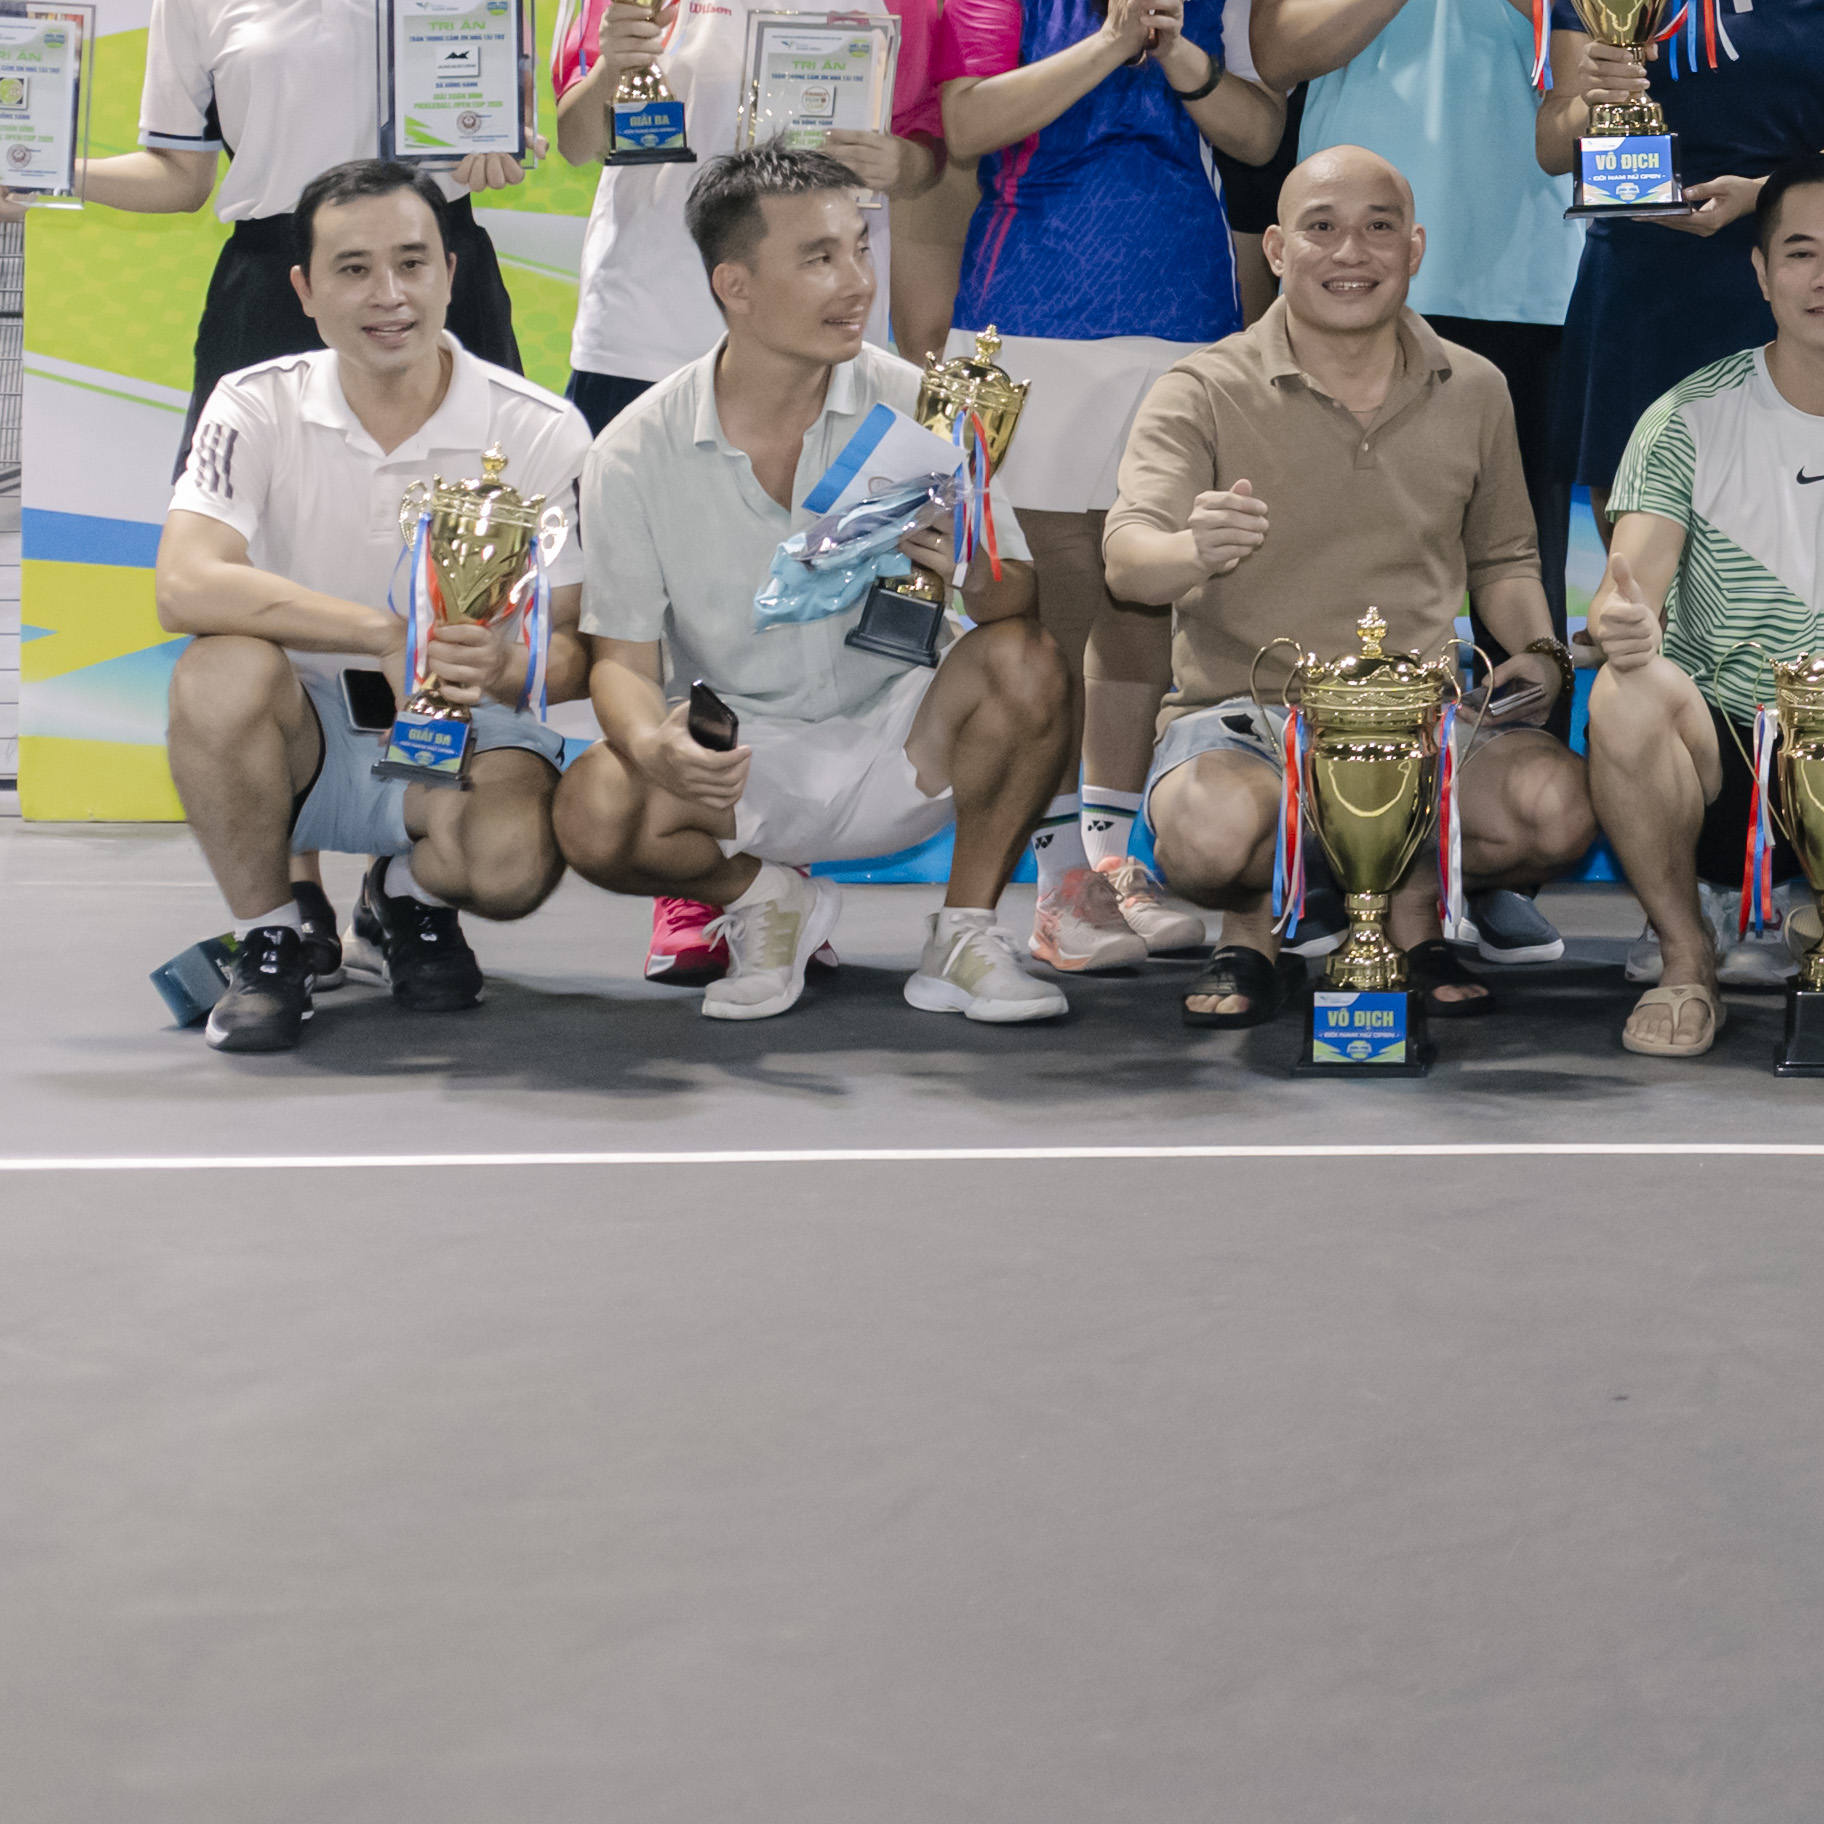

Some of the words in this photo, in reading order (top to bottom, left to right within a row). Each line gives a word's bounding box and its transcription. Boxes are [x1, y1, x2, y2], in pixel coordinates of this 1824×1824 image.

[689, 2, 732, 16] Wilson
[428, 21, 455, 31] TRI
[460, 19, 486, 30] ÂN
[792, 60, 816, 70] TRI
[821, 59, 846, 70] ÂN
[1595, 152, 1617, 170] VÔ
[1620, 152, 1660, 171] ĐỊCH
[1327, 1009, 1350, 1027] VÔ
[1353, 1009, 1395, 1029] ĐỊCH
